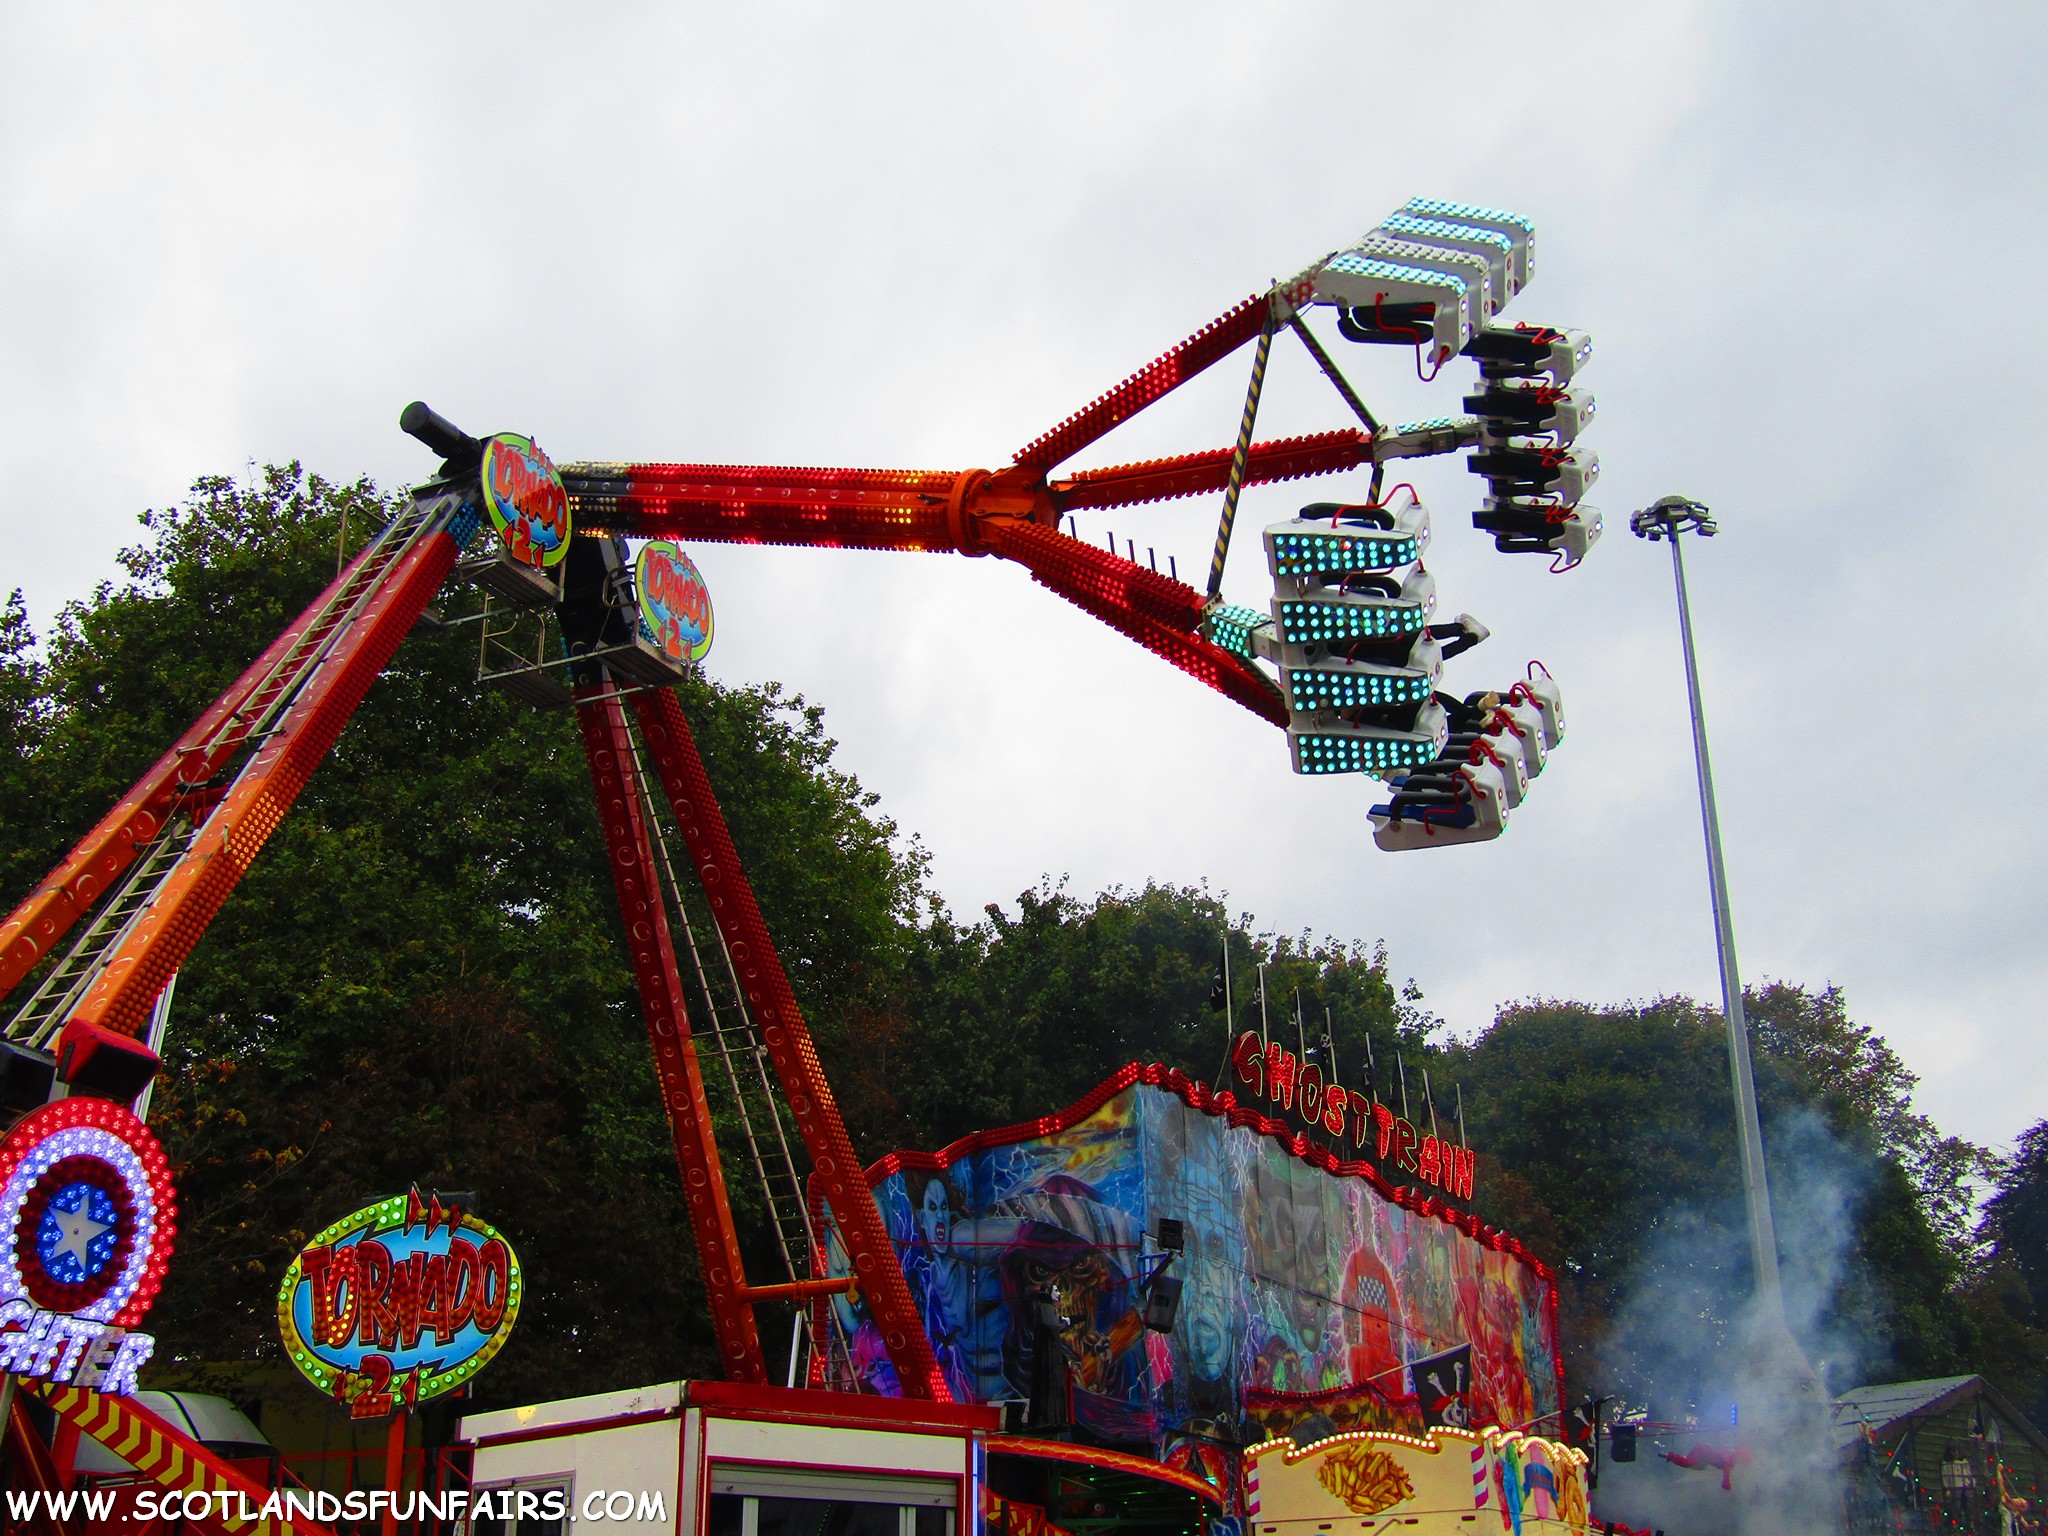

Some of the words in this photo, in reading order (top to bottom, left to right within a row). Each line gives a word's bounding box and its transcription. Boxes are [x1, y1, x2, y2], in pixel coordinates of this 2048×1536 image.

[493, 439, 567, 539] TORNADO
[511, 517, 533, 565] 2
[645, 547, 709, 635] TORNADO
[665, 616, 682, 660] 2
[1233, 1030, 1370, 1148] GHOST
[1372, 1103, 1475, 1200] TRAIN
[301, 1236, 507, 1346] TORNADO
[351, 1354, 394, 1419] 2
